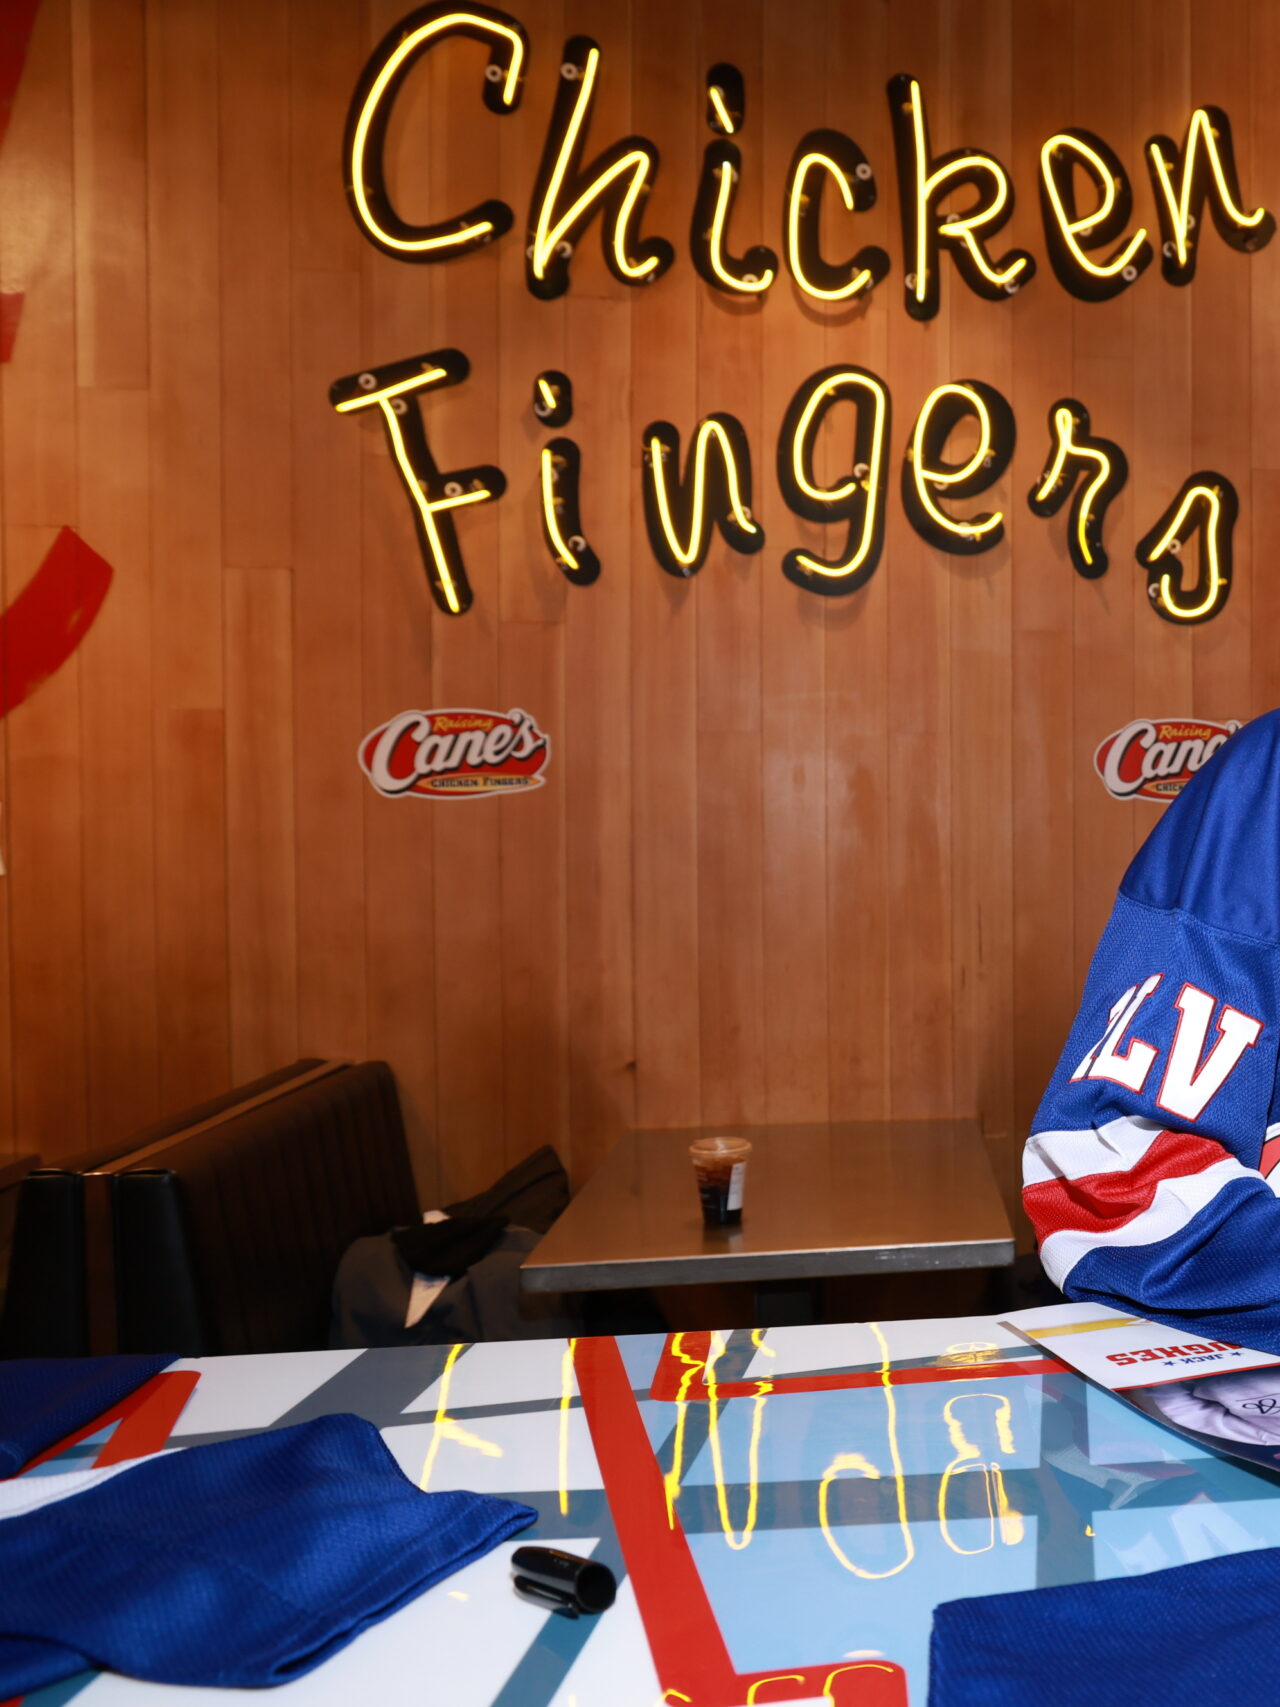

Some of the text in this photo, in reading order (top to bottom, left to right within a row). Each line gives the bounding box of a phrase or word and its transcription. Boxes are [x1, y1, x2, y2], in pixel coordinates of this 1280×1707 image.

[343, 2, 1277, 320] Chicken
[330, 349, 1238, 624] Fingers
[371, 711, 545, 794] Cane's
[1159, 724, 1212, 740] Raising
[1106, 1341, 1244, 1367] UGHES
[1179, 1353, 1223, 1364] JACK
